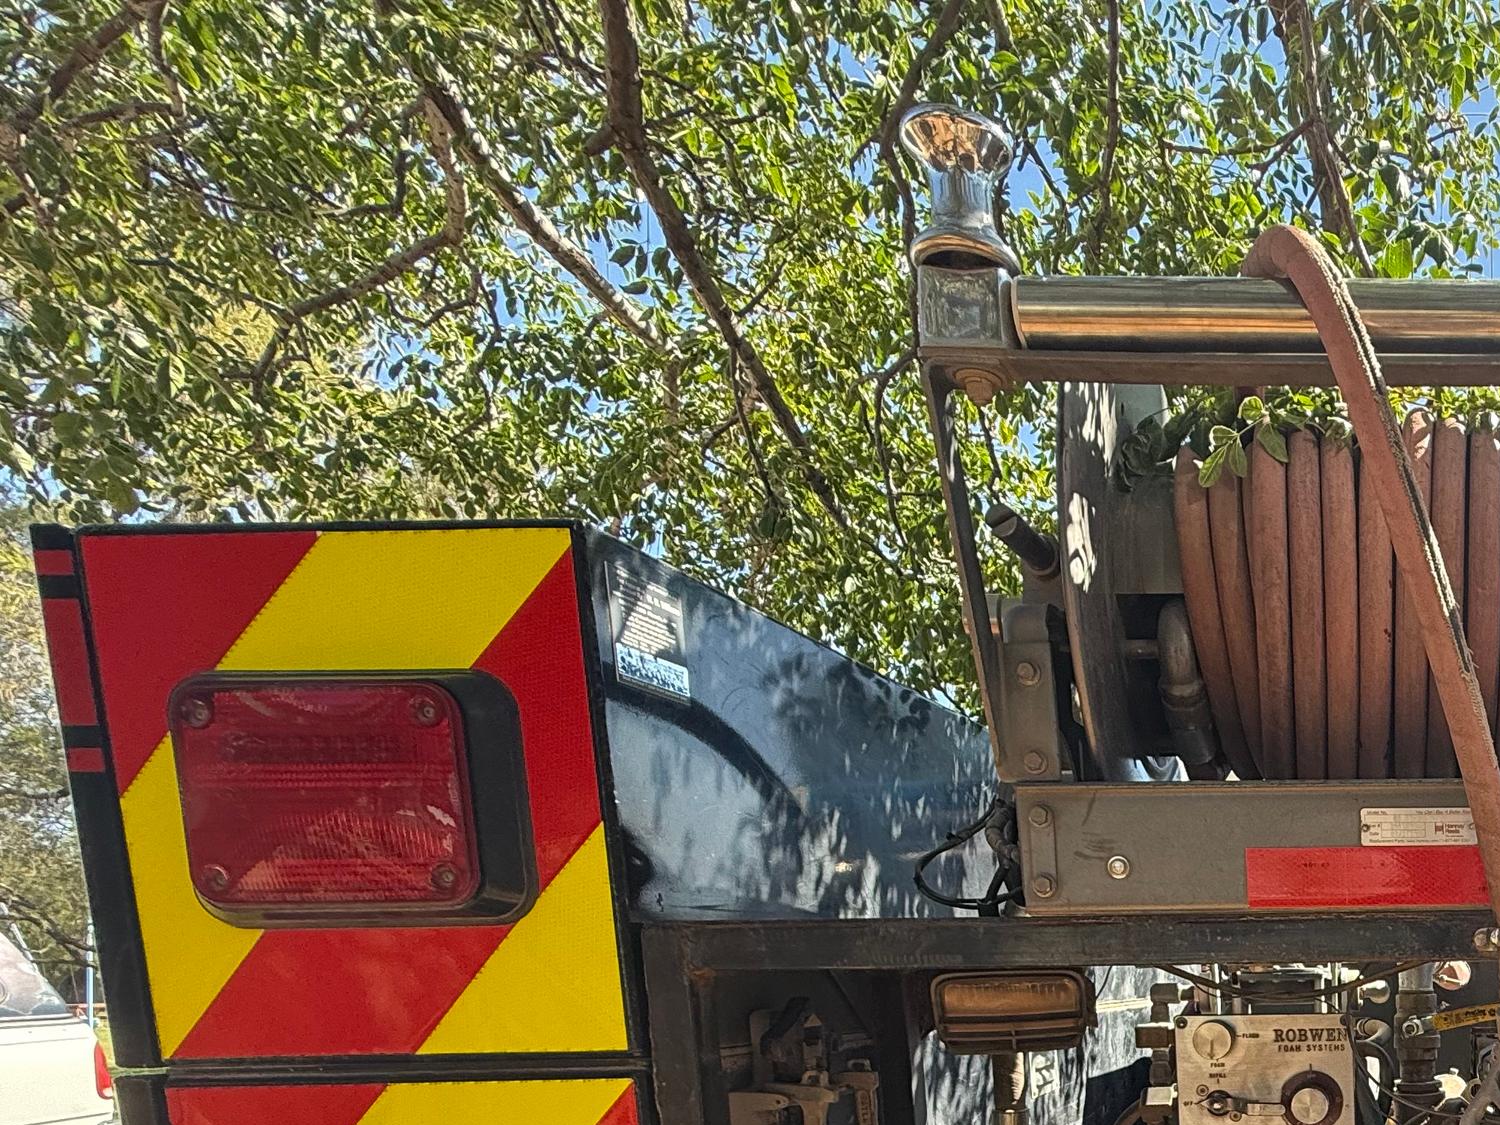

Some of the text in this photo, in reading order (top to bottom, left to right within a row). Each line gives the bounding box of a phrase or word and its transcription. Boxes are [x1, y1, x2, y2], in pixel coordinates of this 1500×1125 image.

[1272, 1028, 1348, 1042] ROBWEN
[1278, 1043, 1346, 1053] FOAM SYSTEMS
